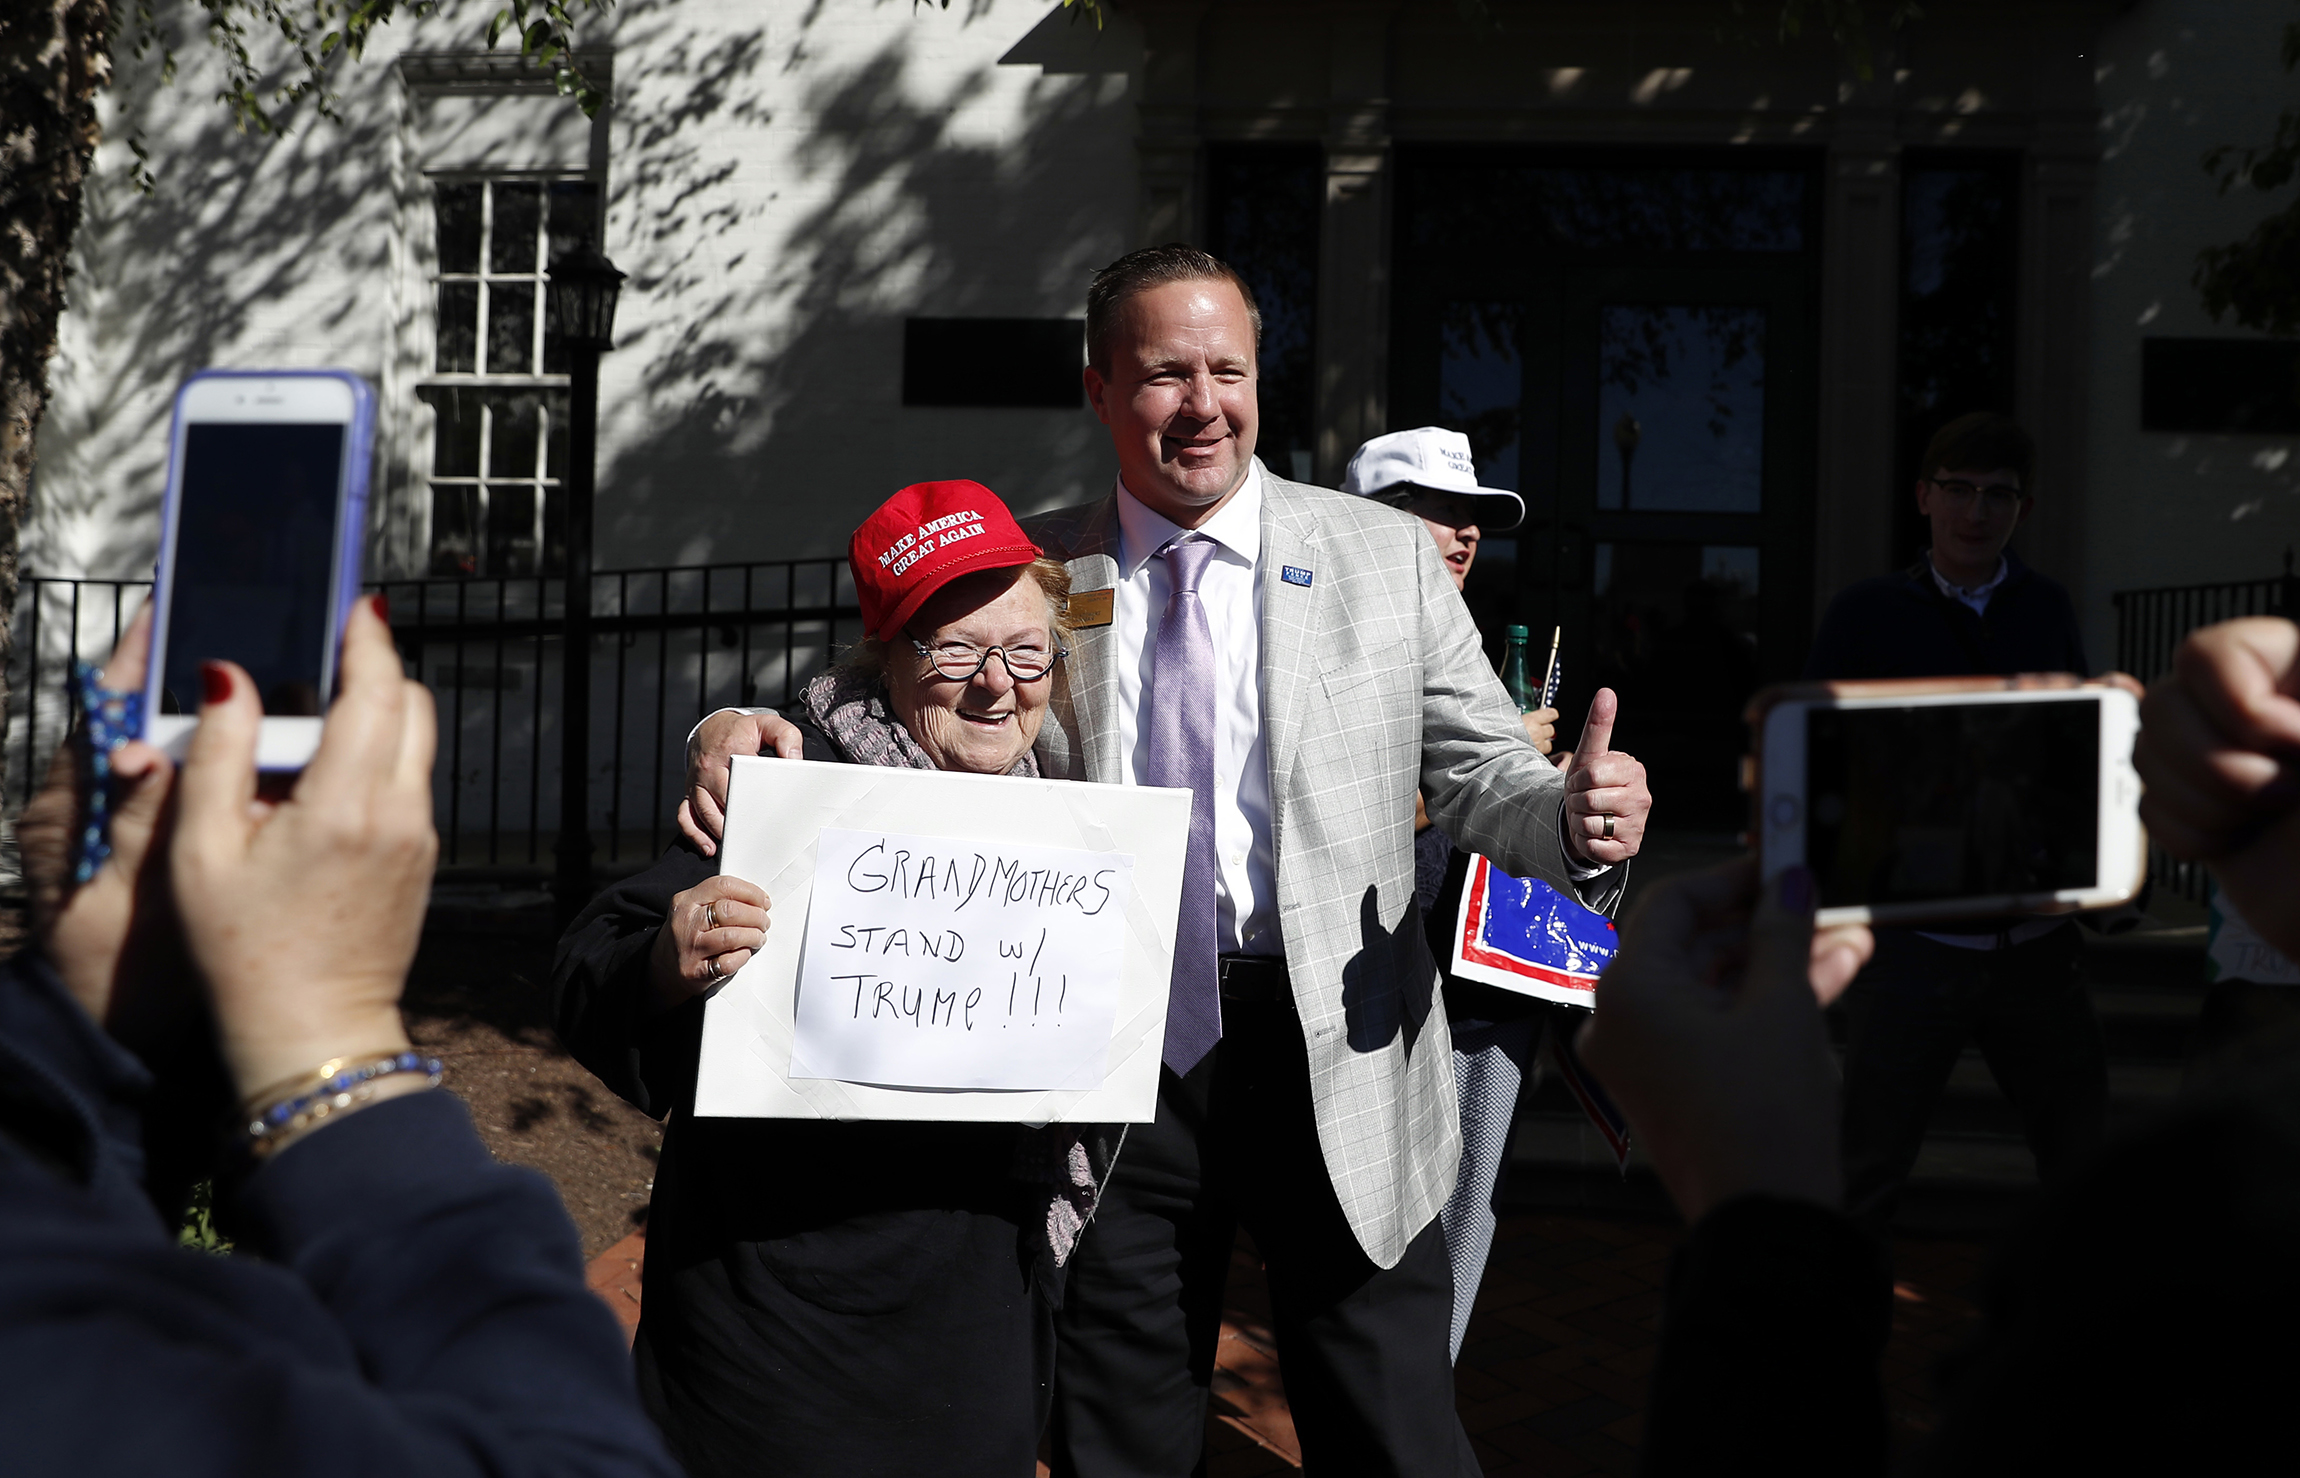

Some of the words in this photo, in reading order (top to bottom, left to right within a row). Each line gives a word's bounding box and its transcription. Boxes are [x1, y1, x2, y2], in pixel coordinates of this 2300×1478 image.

[878, 533, 917, 569] MAKE
[918, 509, 985, 541] AMERICA
[892, 539, 936, 577] GREAT
[939, 523, 986, 547] AGAIN
[1284, 567, 1311, 576] TRUMP
[847, 838, 1116, 915] GRANDMOTHERS
[830, 924, 965, 962] STAND
